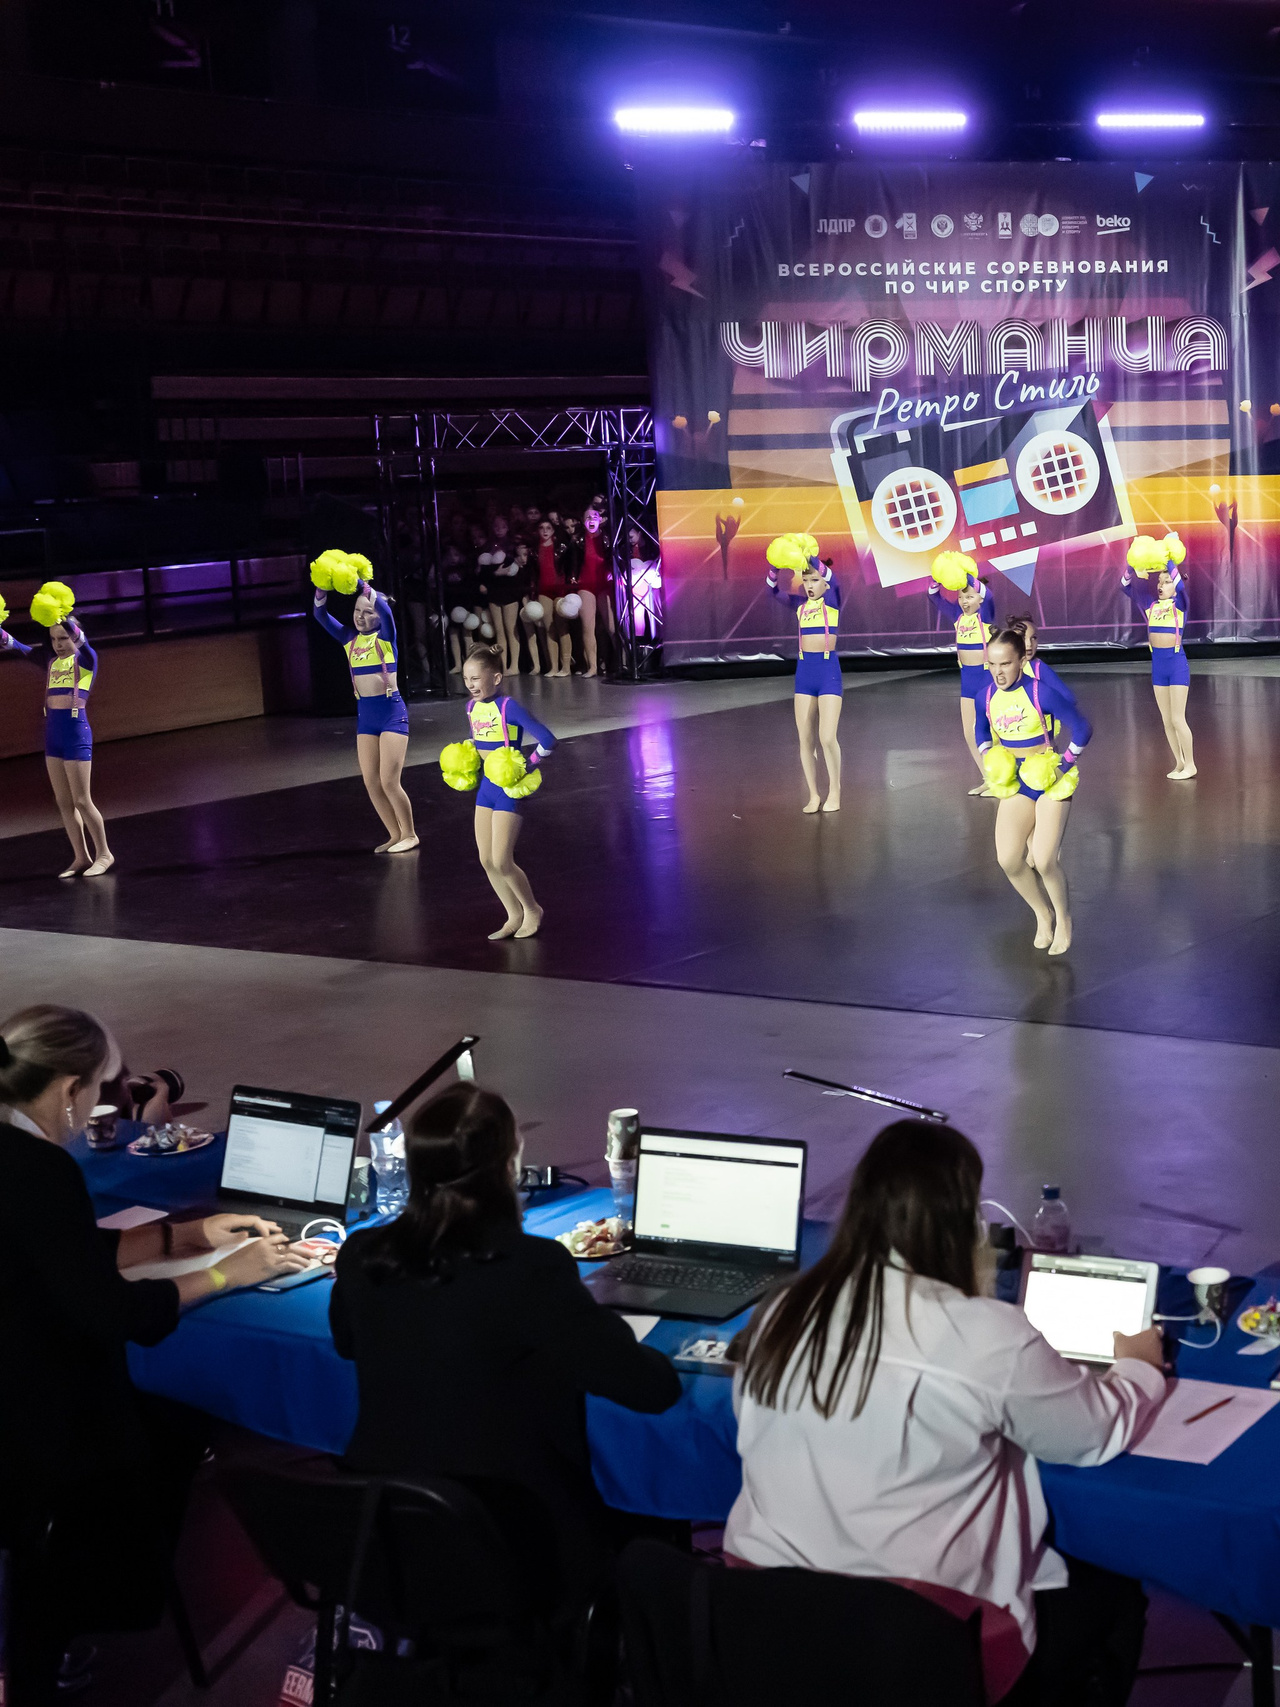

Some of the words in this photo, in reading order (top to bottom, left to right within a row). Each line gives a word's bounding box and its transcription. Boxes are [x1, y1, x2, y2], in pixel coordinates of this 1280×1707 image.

[816, 218, 856, 235] ЛДПР
[1096, 214, 1131, 228] beko
[778, 259, 976, 277] ВСЕРОССИЙСКИЕ
[986, 260, 1169, 275] СОРЕВНОВАНИЯ
[885, 280, 915, 294] ПО
[925, 280, 970, 294] ЧИР
[980, 279, 1068, 293] СПОРТУ
[872, 388, 981, 432] Ретро
[994, 370, 1101, 411] Стиль
